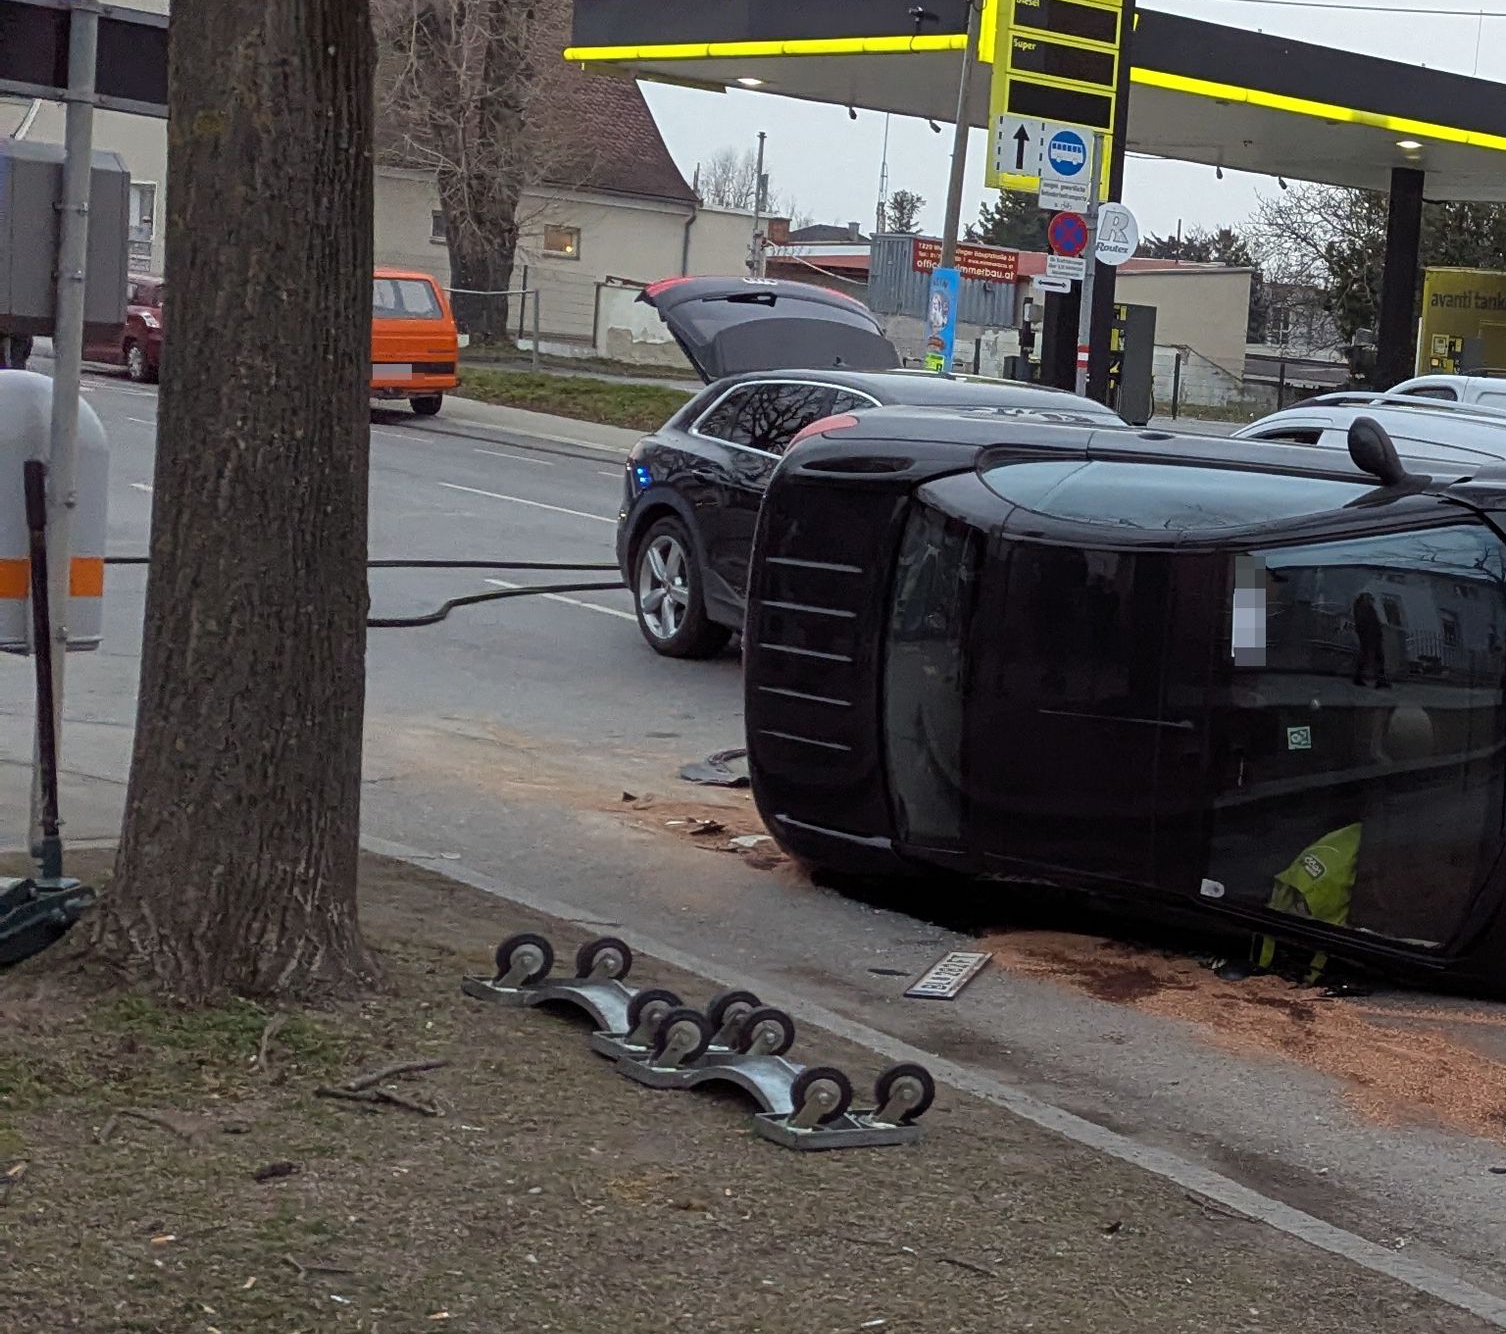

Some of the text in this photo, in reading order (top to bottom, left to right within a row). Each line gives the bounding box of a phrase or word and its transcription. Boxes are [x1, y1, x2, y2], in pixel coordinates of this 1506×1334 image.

[1013, 38, 1037, 51] Super
[1097, 241, 1129, 254] Routex
[1430, 291, 1472, 309] avanti
